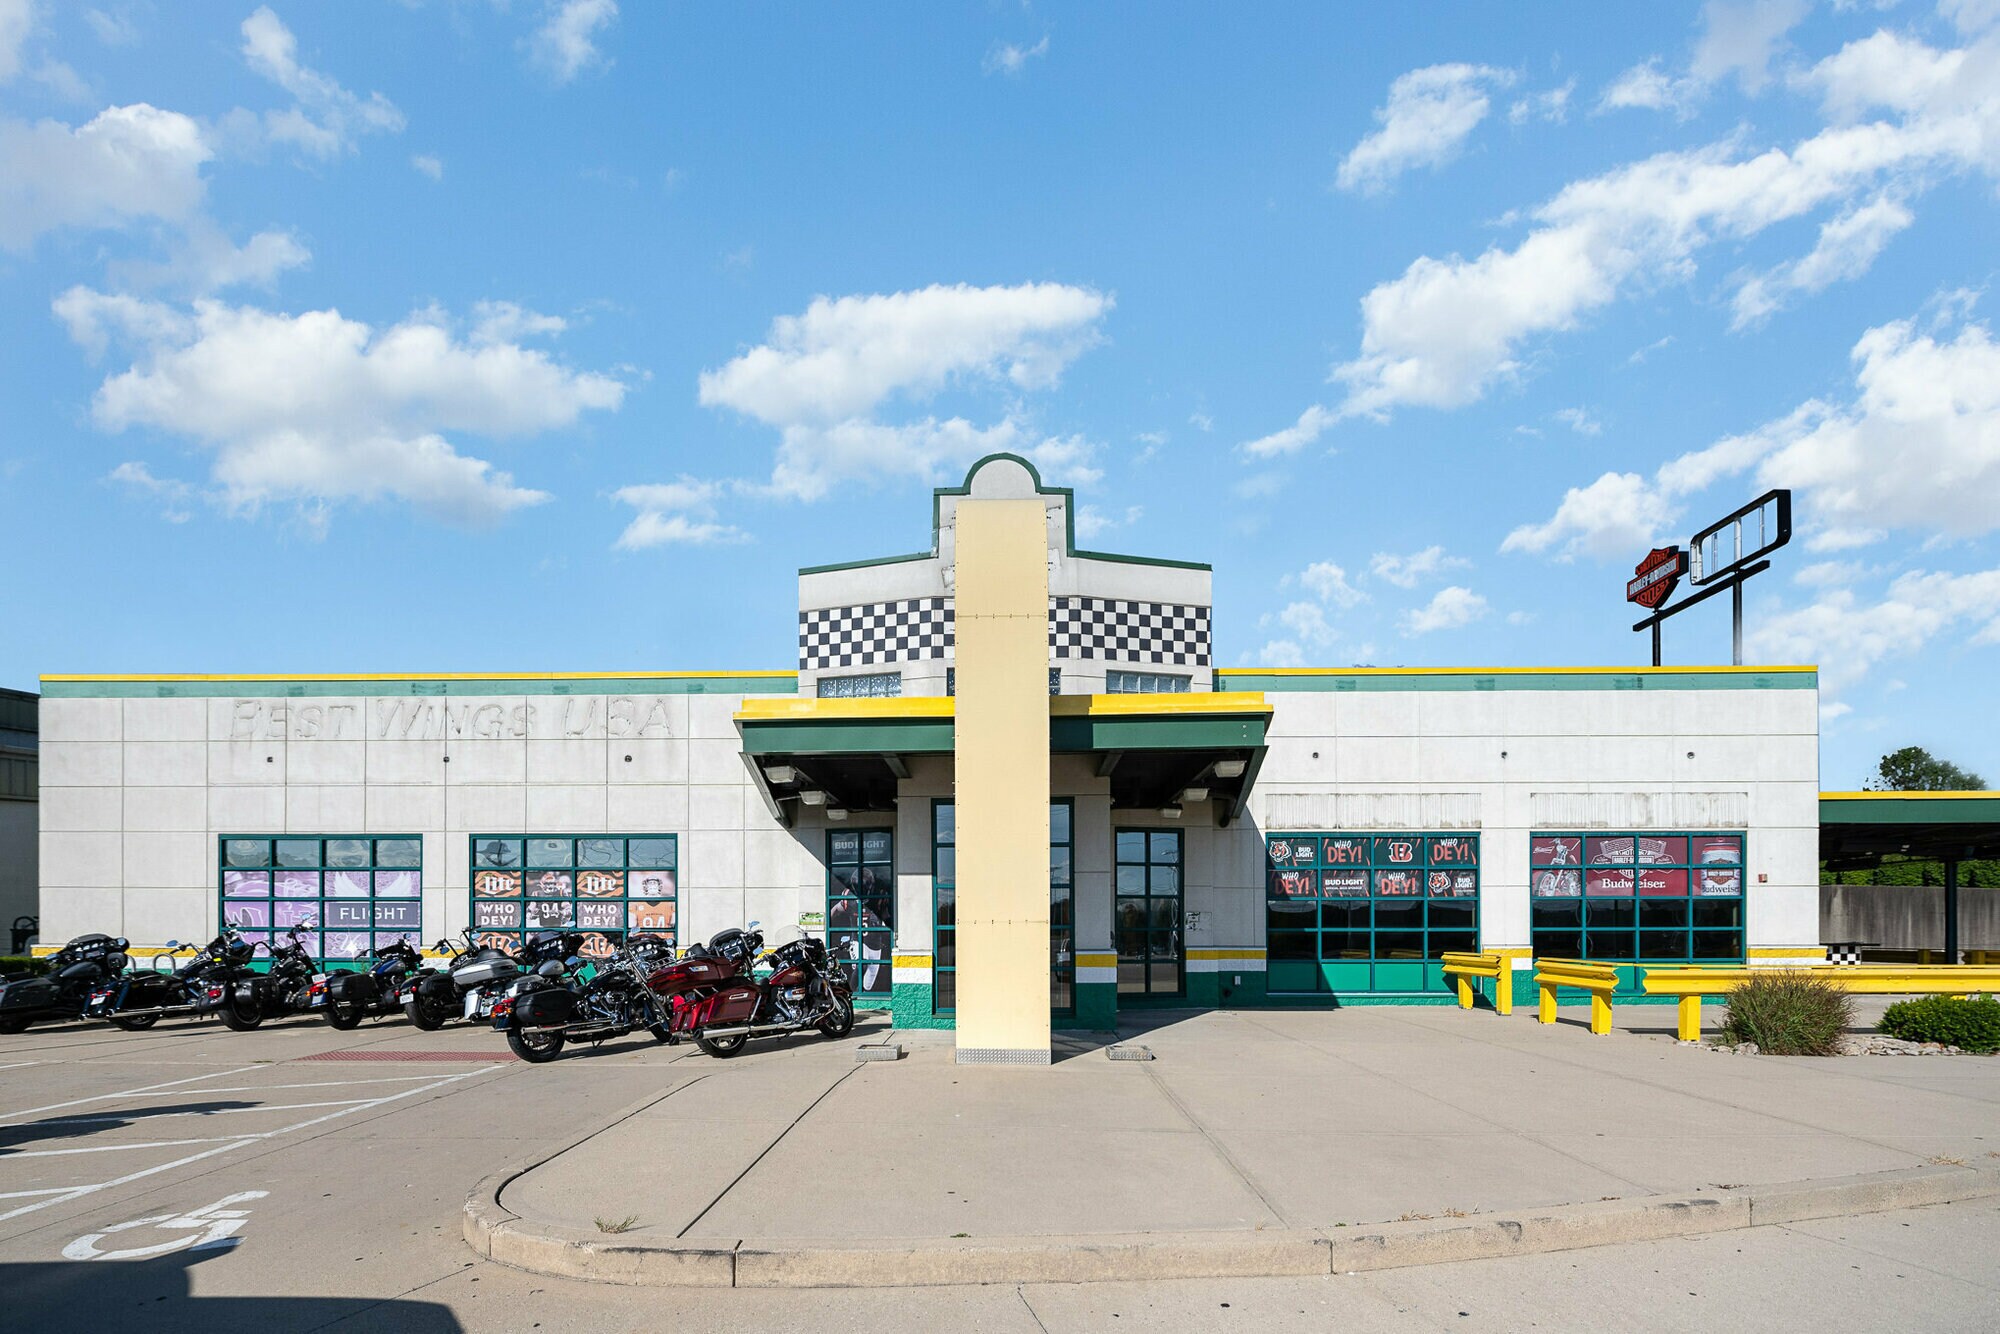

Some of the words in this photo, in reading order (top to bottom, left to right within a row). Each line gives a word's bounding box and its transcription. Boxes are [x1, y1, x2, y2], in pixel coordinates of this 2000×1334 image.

[230, 698, 357, 738] BEST
[376, 698, 537, 738] WINGS
[563, 698, 673, 738] USA
[834, 841, 854, 850] BUD
[1334, 839, 1351, 849] WHO
[1441, 838, 1458, 847] WHO
[1327, 845, 1362, 863] DEY!
[1433, 844, 1468, 862] DEY!
[1282, 872, 1299, 881] WHO
[1388, 872, 1405, 881] WHO
[484, 875, 515, 895] Lite
[586, 875, 617, 895] Lite
[1275, 878, 1309, 895] DEY!
[1381, 877, 1416, 895] DEY!
[339, 907, 407, 920] FLIGHT
[481, 904, 515, 914] WHO
[584, 904, 617, 914] WHO
[481, 915, 514, 926] DEY!
[584, 915, 616, 926] DEY!
